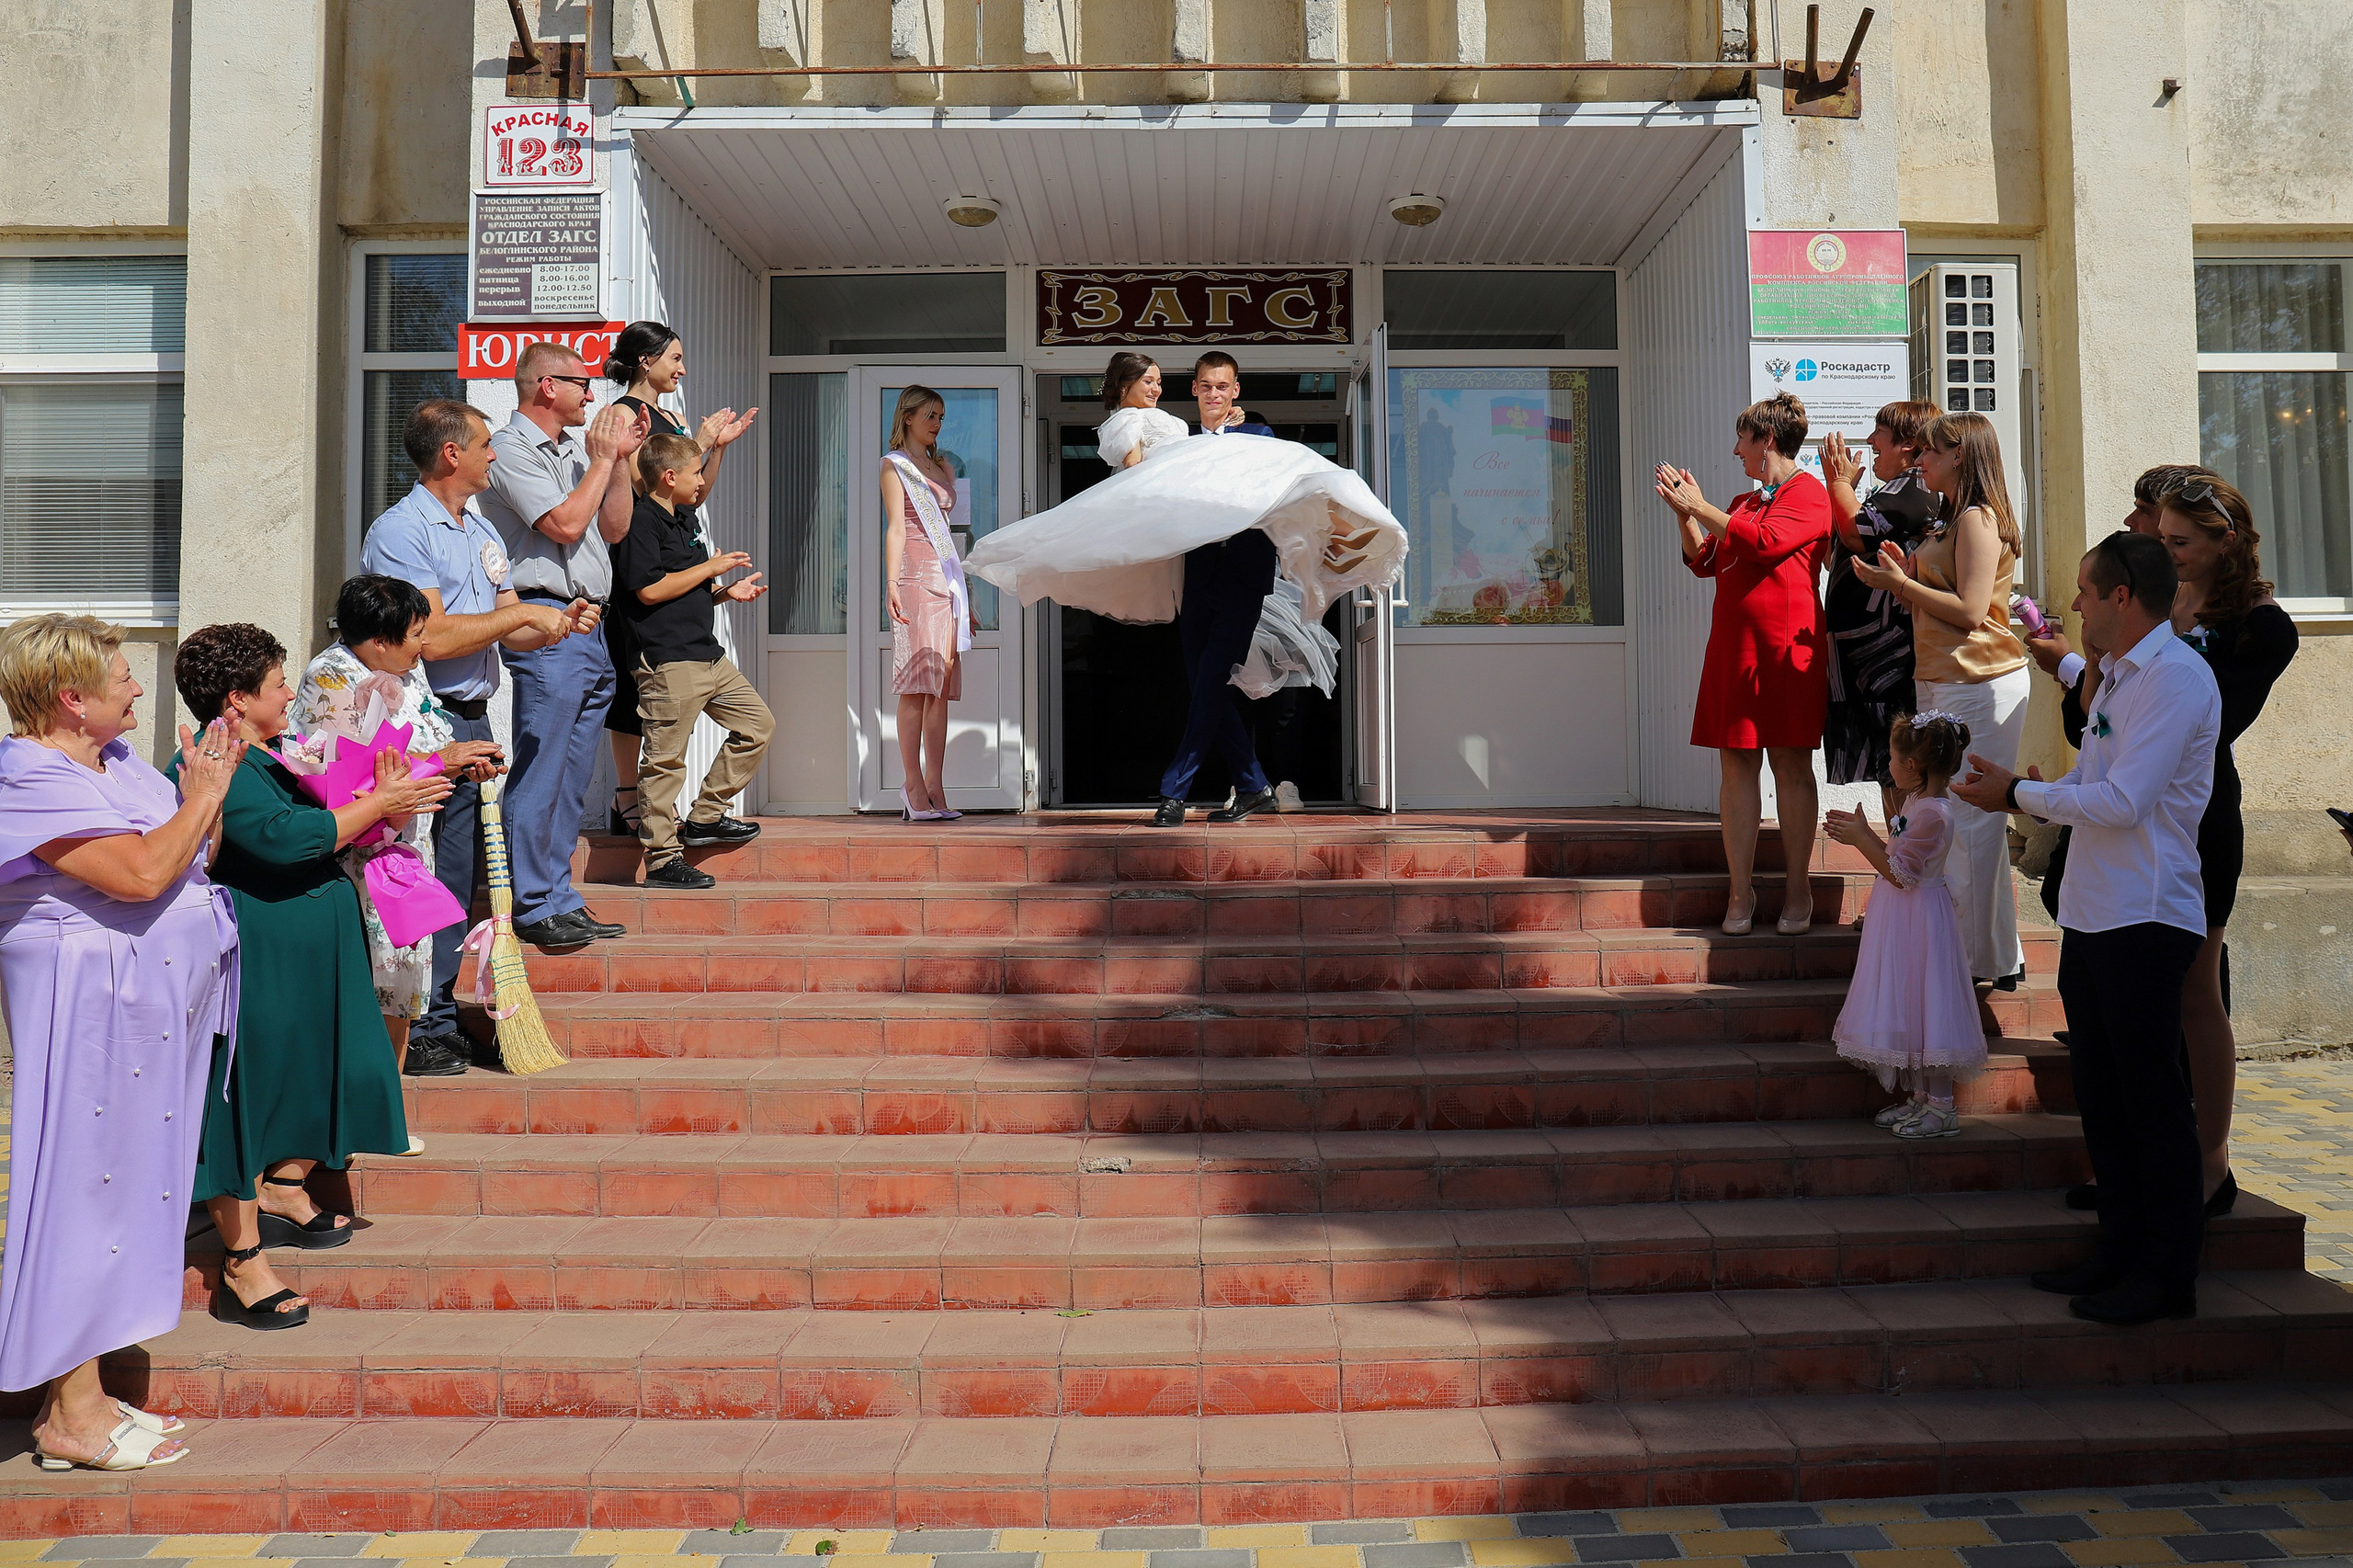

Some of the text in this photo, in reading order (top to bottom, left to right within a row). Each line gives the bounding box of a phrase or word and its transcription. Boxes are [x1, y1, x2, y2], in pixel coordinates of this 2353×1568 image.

[491, 111, 590, 137] КРАСНАЯ
[496, 137, 584, 176] 123
[479, 212, 548, 221] ГРАЖДАНСКОГО
[481, 229, 597, 246] ОТДЕЛ ЗАГС
[479, 244, 599, 256] БЕЛОГЛИНСКОГО РАЙОНА
[479, 265, 590, 275] ежедневно 8.00-17.00
[479, 274, 590, 284] пятница 8.00-16.00
[479, 284, 592, 294] перерыв 12.00-12.50
[478, 299, 526, 308] выходной
[534, 294, 595, 303] воскресенье
[534, 302, 596, 311] понедельник
[1071, 284, 1319, 329] ЗАГС
[1821, 361, 1891, 374] Роскадастр
[1472, 450, 1510, 470] Все
[1463, 487, 1540, 497] начинается
[1501, 508, 1561, 525] с семьи!
